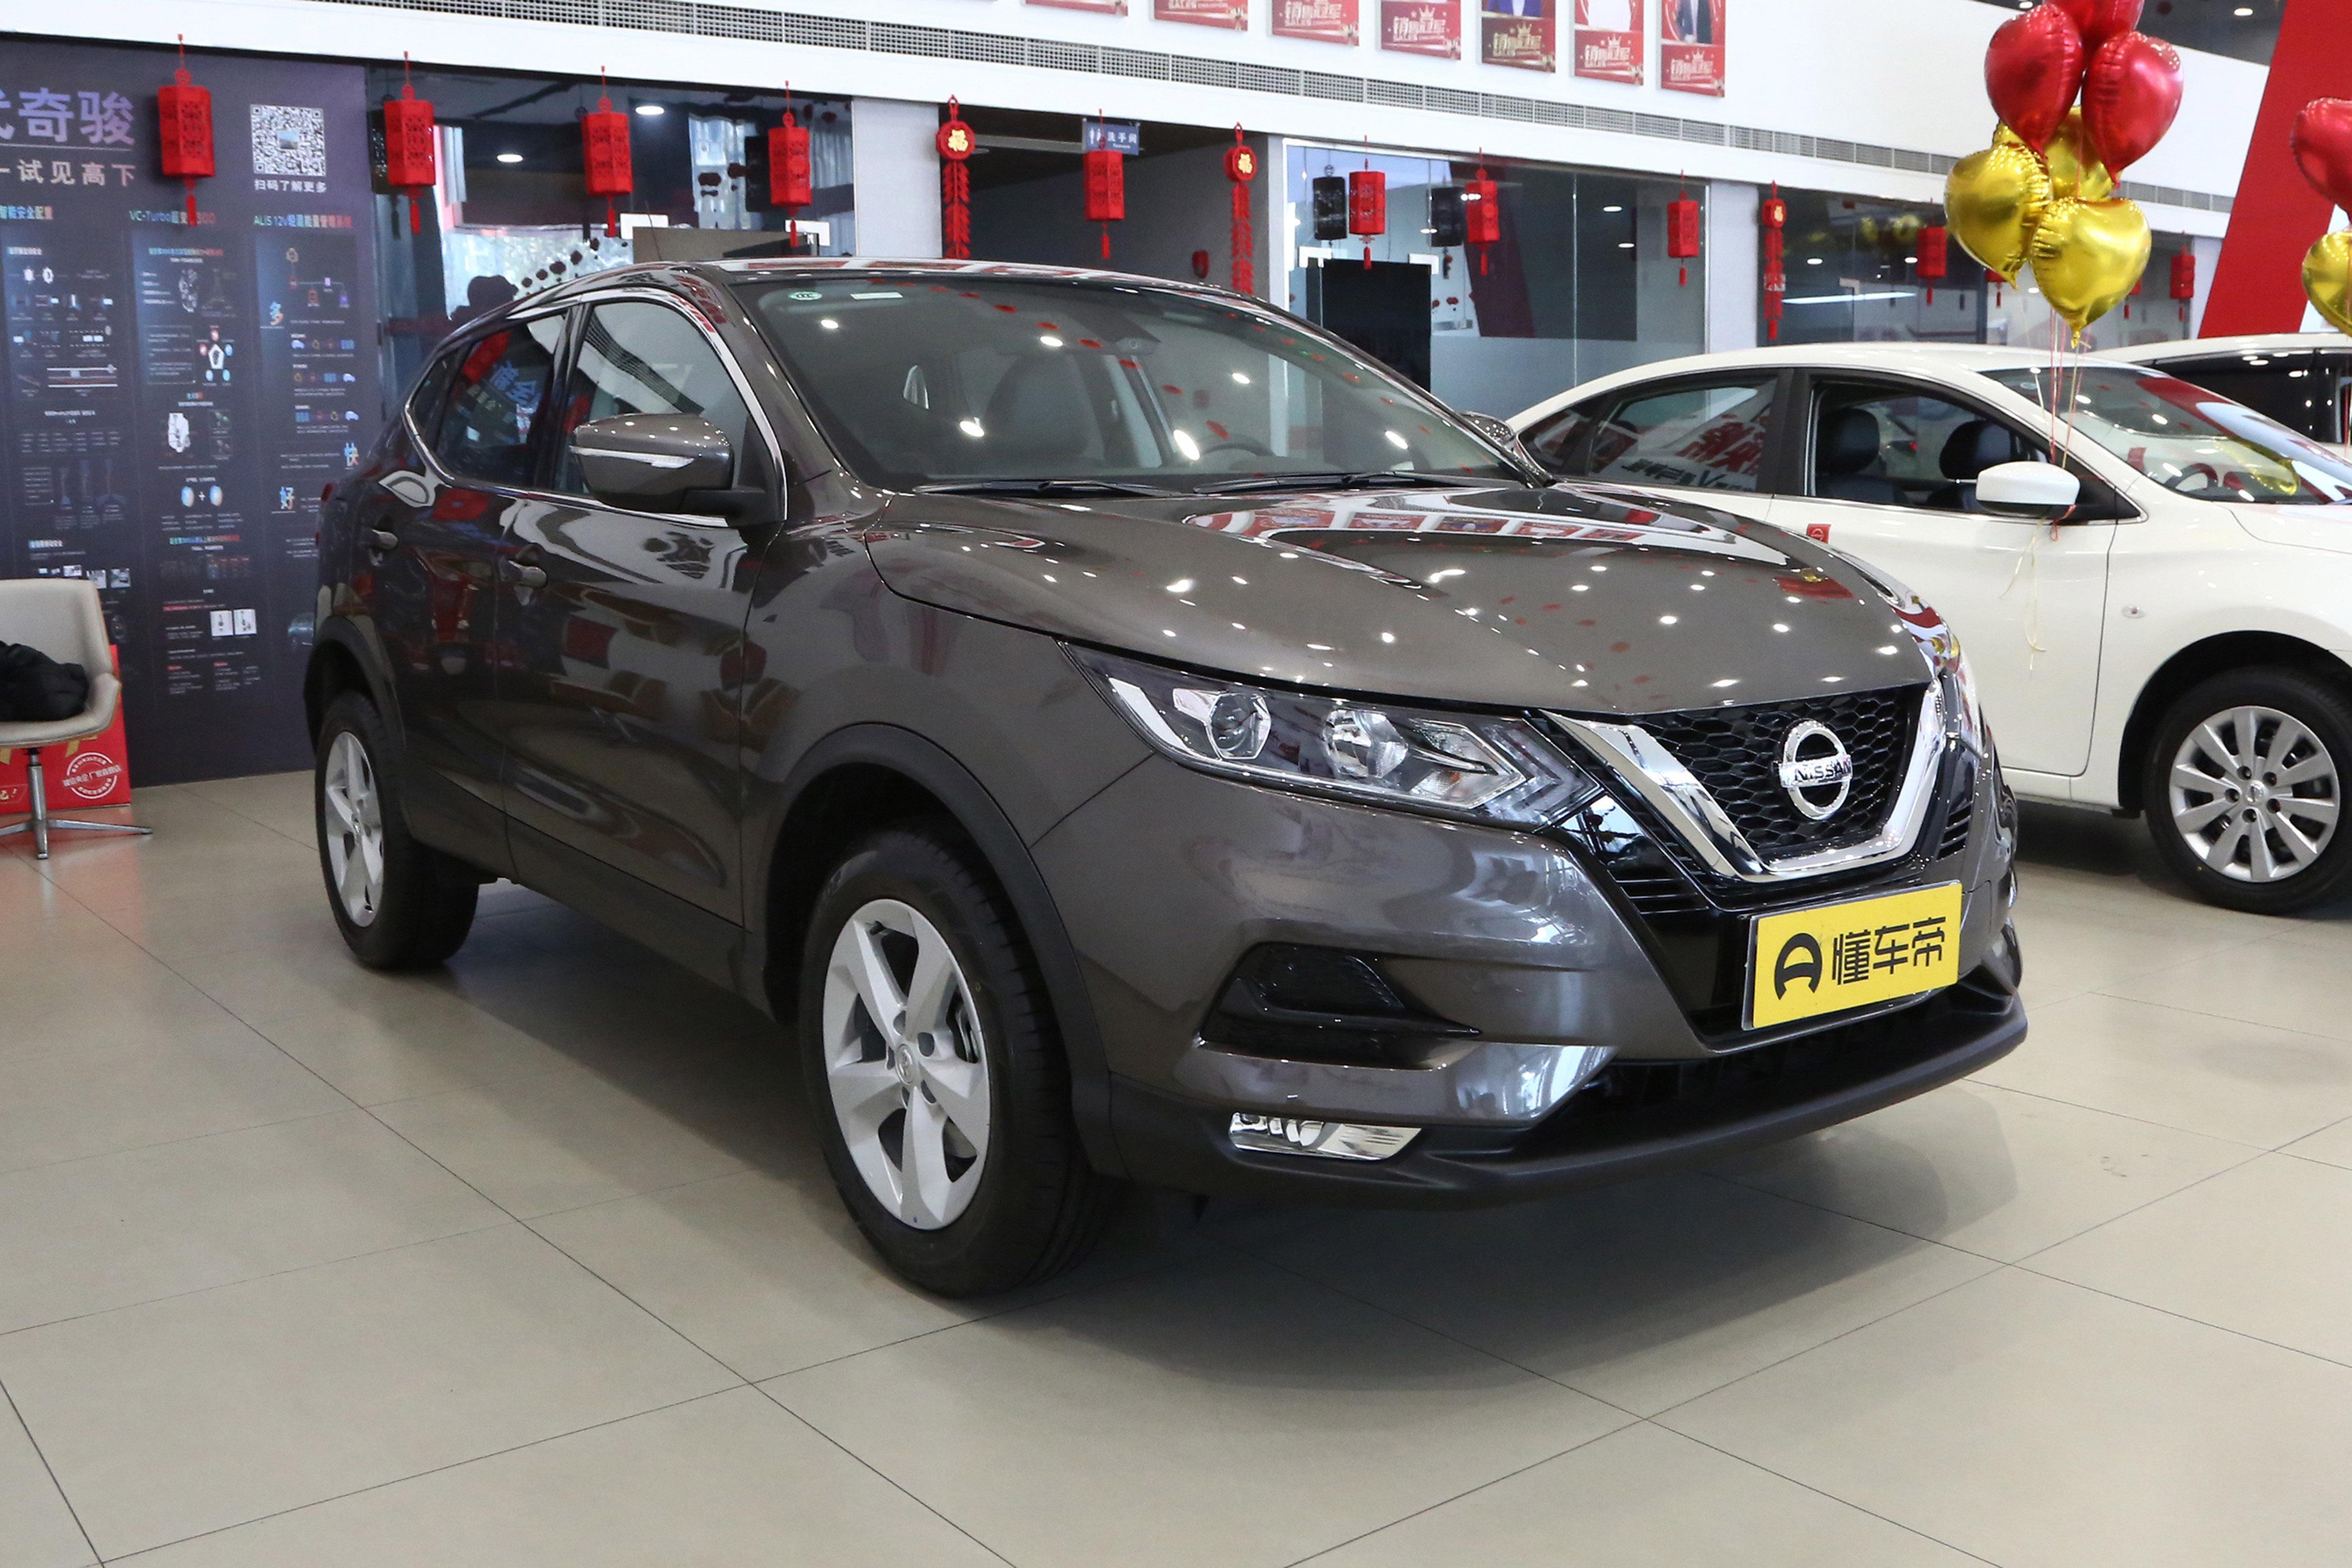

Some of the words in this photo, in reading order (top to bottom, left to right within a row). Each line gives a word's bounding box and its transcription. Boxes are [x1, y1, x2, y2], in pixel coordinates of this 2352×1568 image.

[0, 87, 135, 145] 奇骏
[1794, 758, 1852, 781] NISSAN
[1832, 915, 1946, 986] 懂车帝
